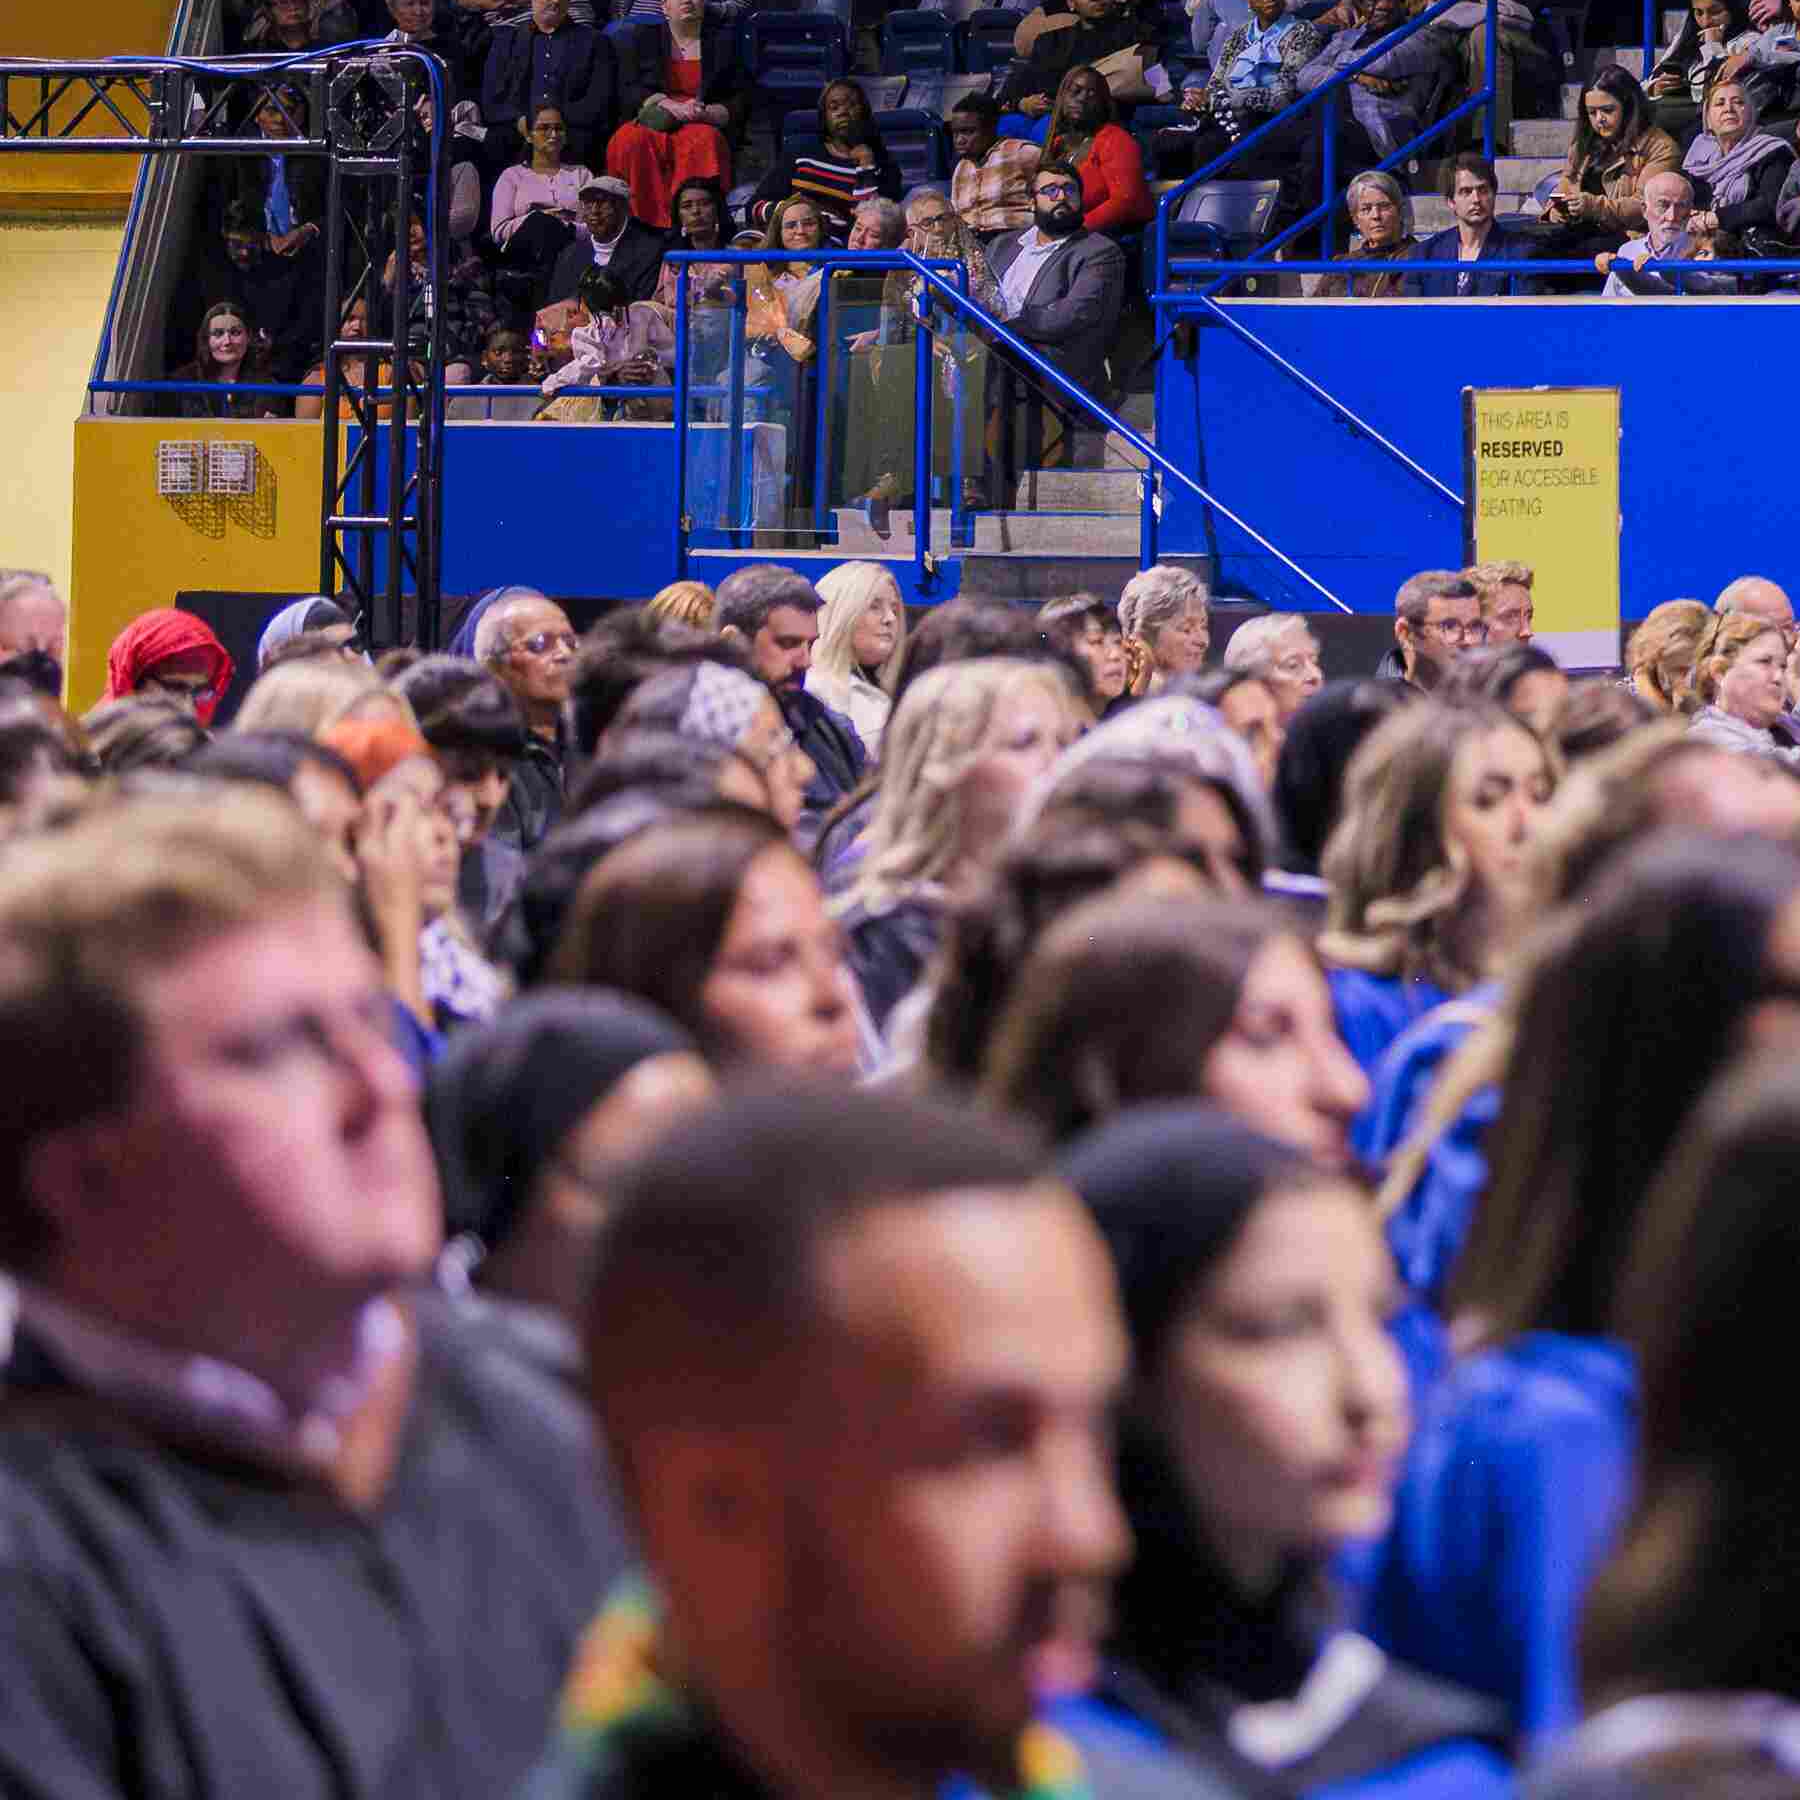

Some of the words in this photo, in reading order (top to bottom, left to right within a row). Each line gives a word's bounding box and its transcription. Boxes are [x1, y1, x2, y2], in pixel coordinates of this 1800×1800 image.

[1480, 411, 1513, 431] THIS
[1516, 410, 1553, 432] AREA
[1555, 410, 1569, 430] IS
[1481, 440, 1564, 458] RESERVED
[1481, 469, 1511, 489] FOR
[1513, 467, 1600, 488] ACCESSIBLE
[1481, 497, 1544, 518] SEATING
